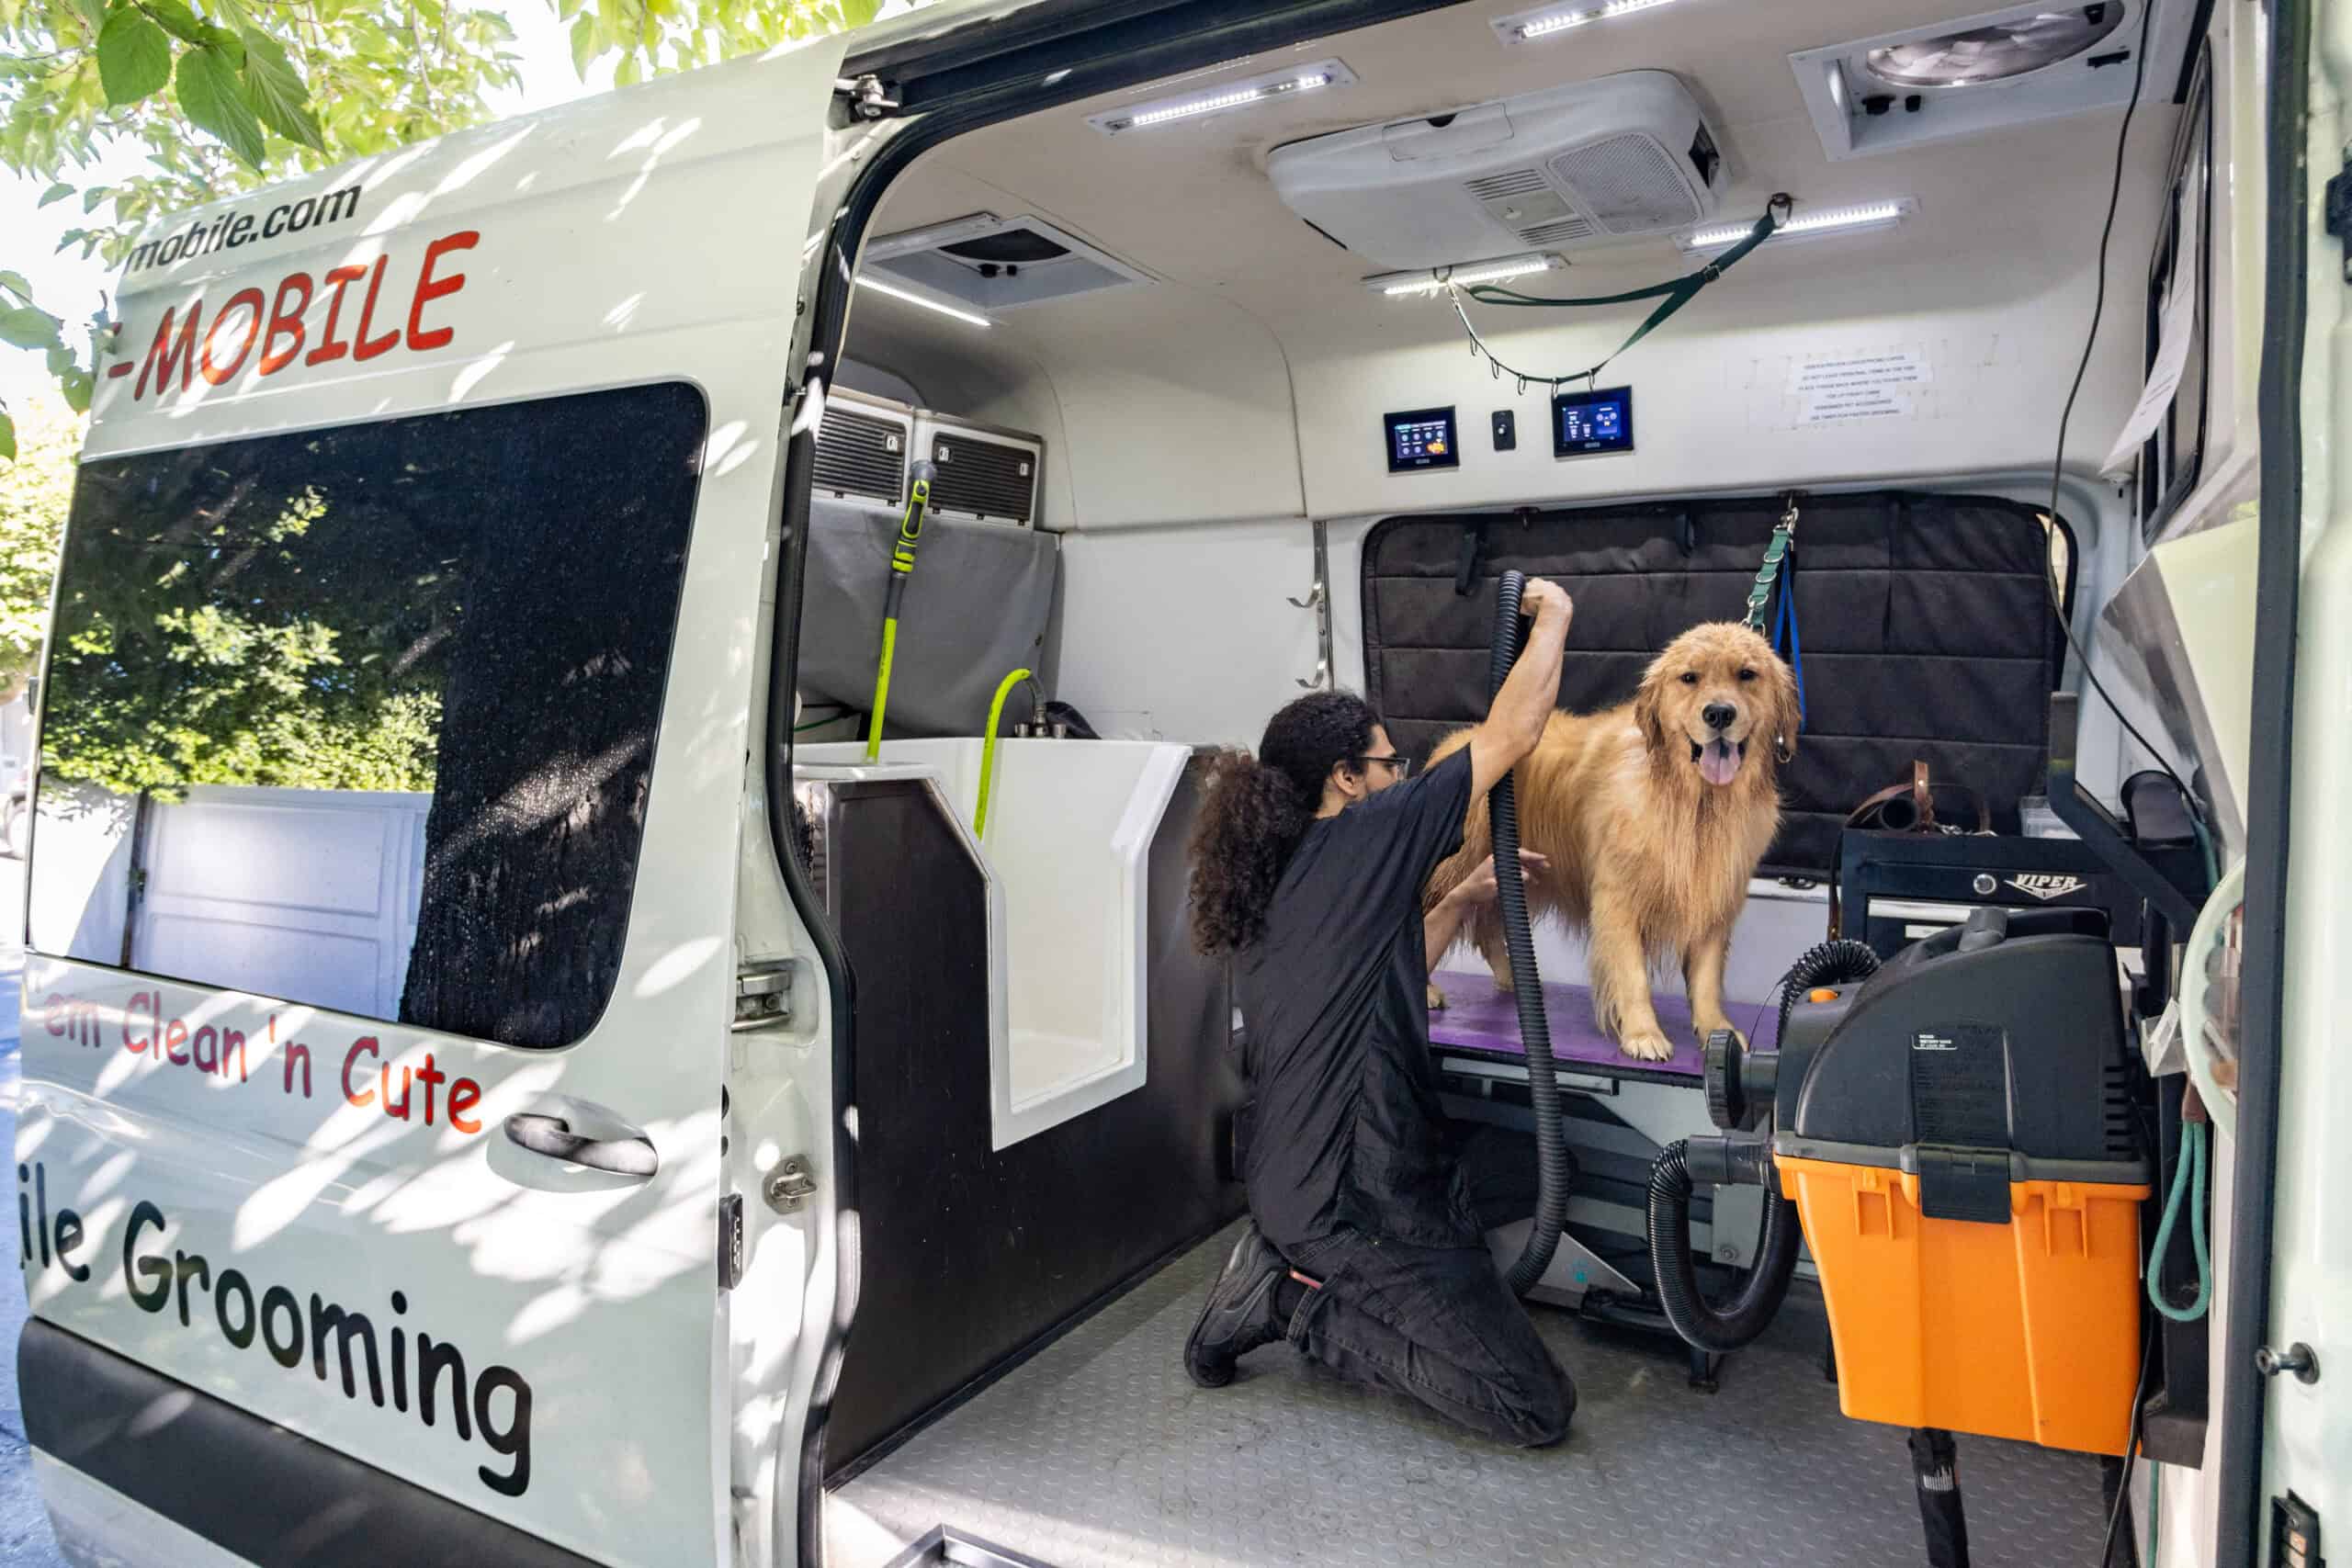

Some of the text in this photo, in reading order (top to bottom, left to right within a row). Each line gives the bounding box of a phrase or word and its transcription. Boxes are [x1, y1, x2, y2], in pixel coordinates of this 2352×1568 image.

[107, 230, 481, 401] -MOBILE
[2015, 874, 2078, 889] VIPER
[122, 991, 248, 1084] Clean
[342, 1036, 483, 1134] Cute
[18, 1162, 533, 1497] ile Grooming
